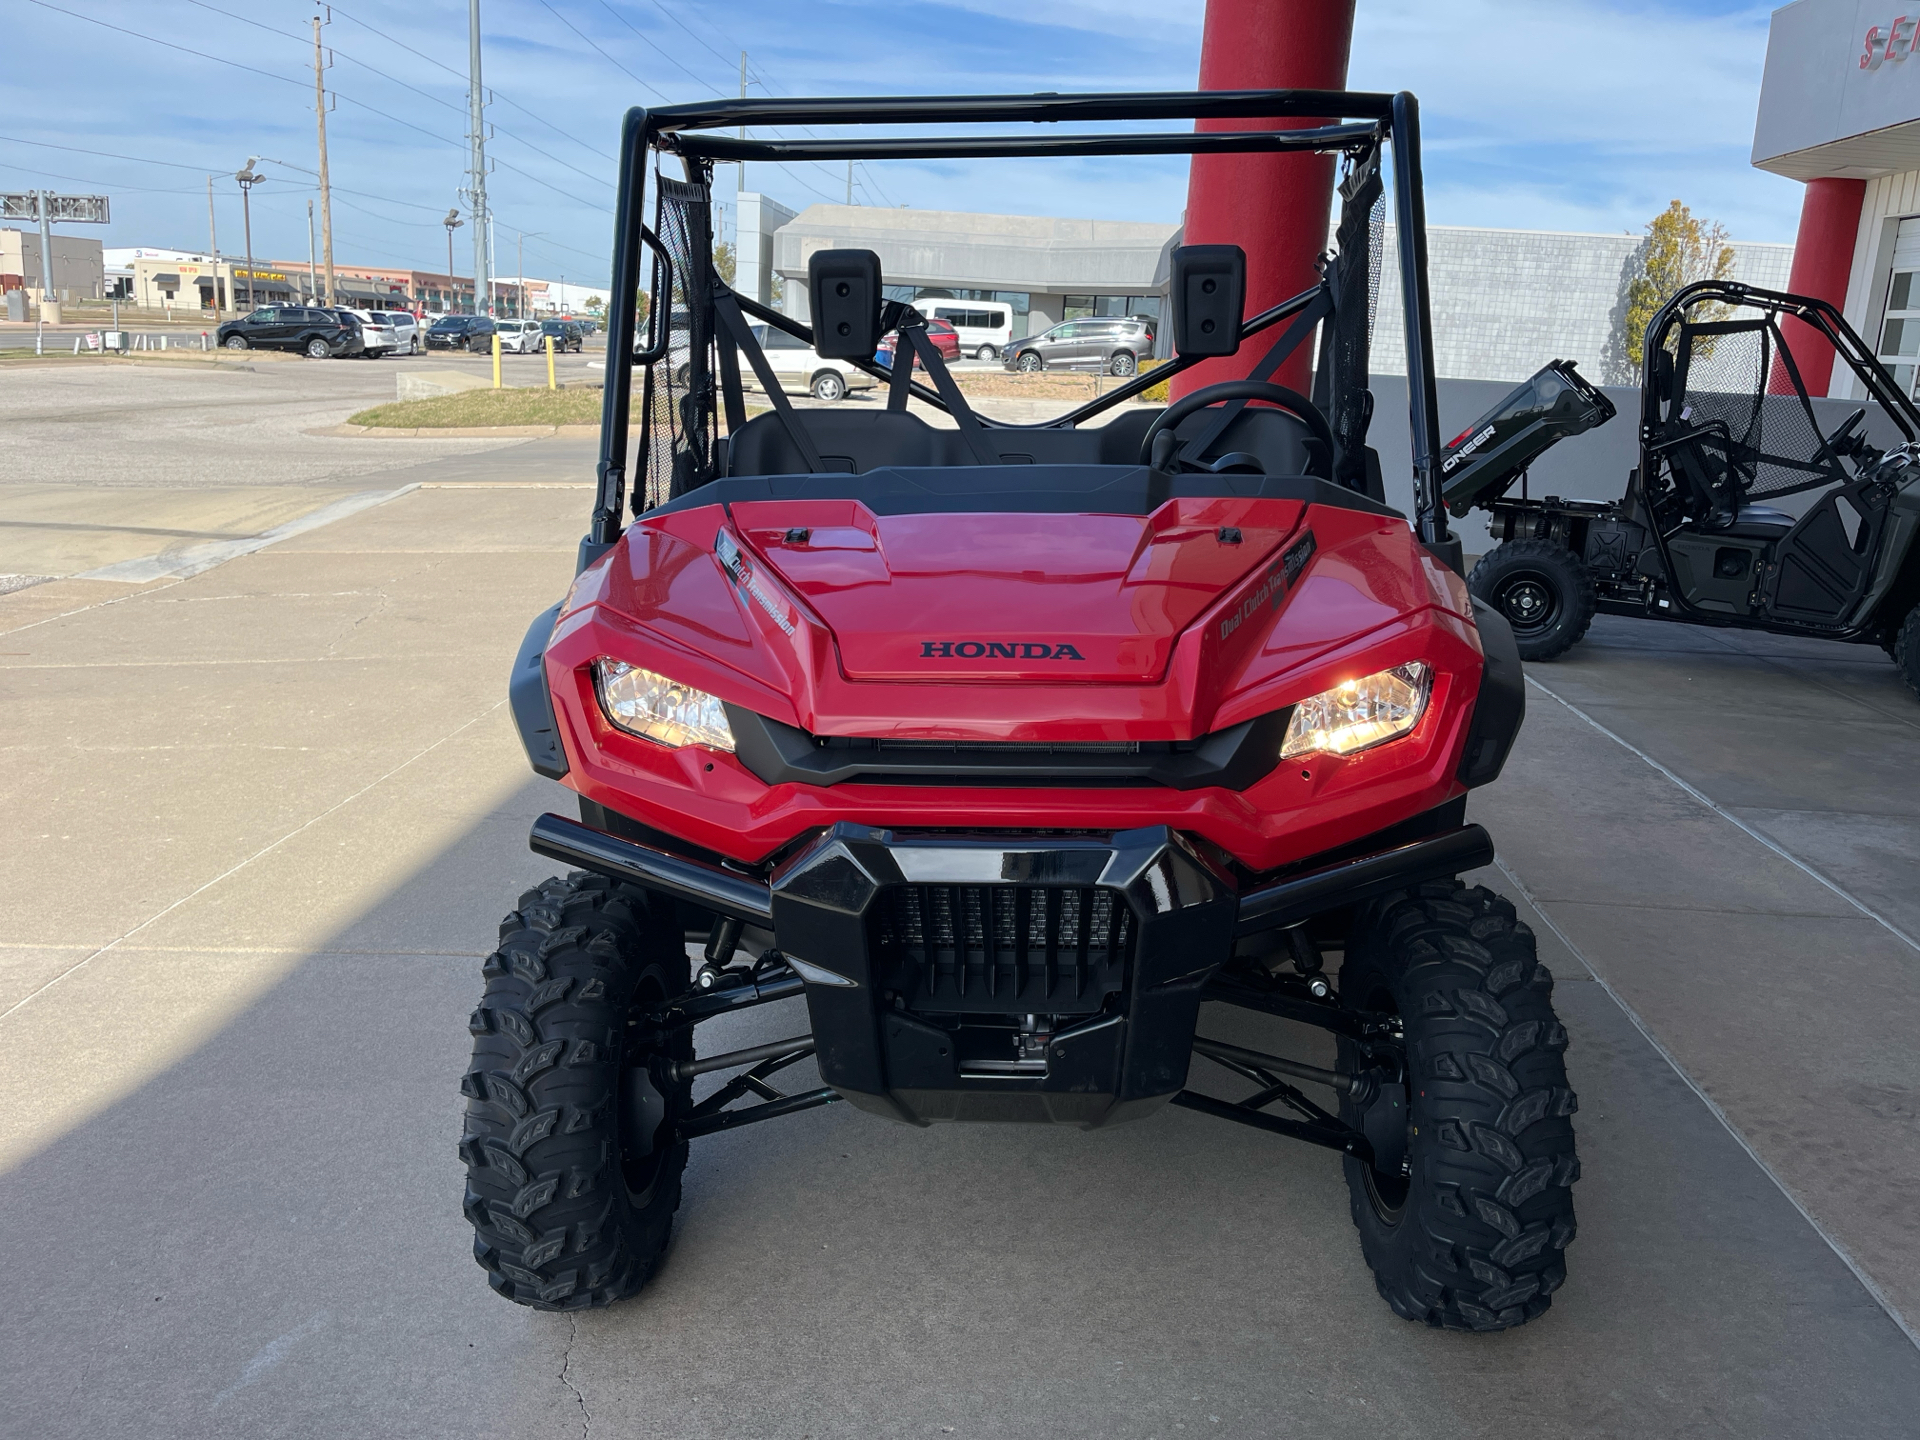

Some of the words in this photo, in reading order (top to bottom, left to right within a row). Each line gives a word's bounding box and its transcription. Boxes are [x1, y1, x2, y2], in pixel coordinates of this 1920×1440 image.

[1441, 424, 1497, 473] IONEER
[1676, 543, 1711, 552] HONDA
[718, 541, 734, 563] Dual
[730, 556, 751, 584] Clutch
[746, 577, 796, 637] Transmission
[1220, 608, 1242, 640] Dual
[1243, 583, 1269, 619] Clutch
[1267, 541, 1311, 591] Transmission
[920, 642, 1086, 660] HONDA
